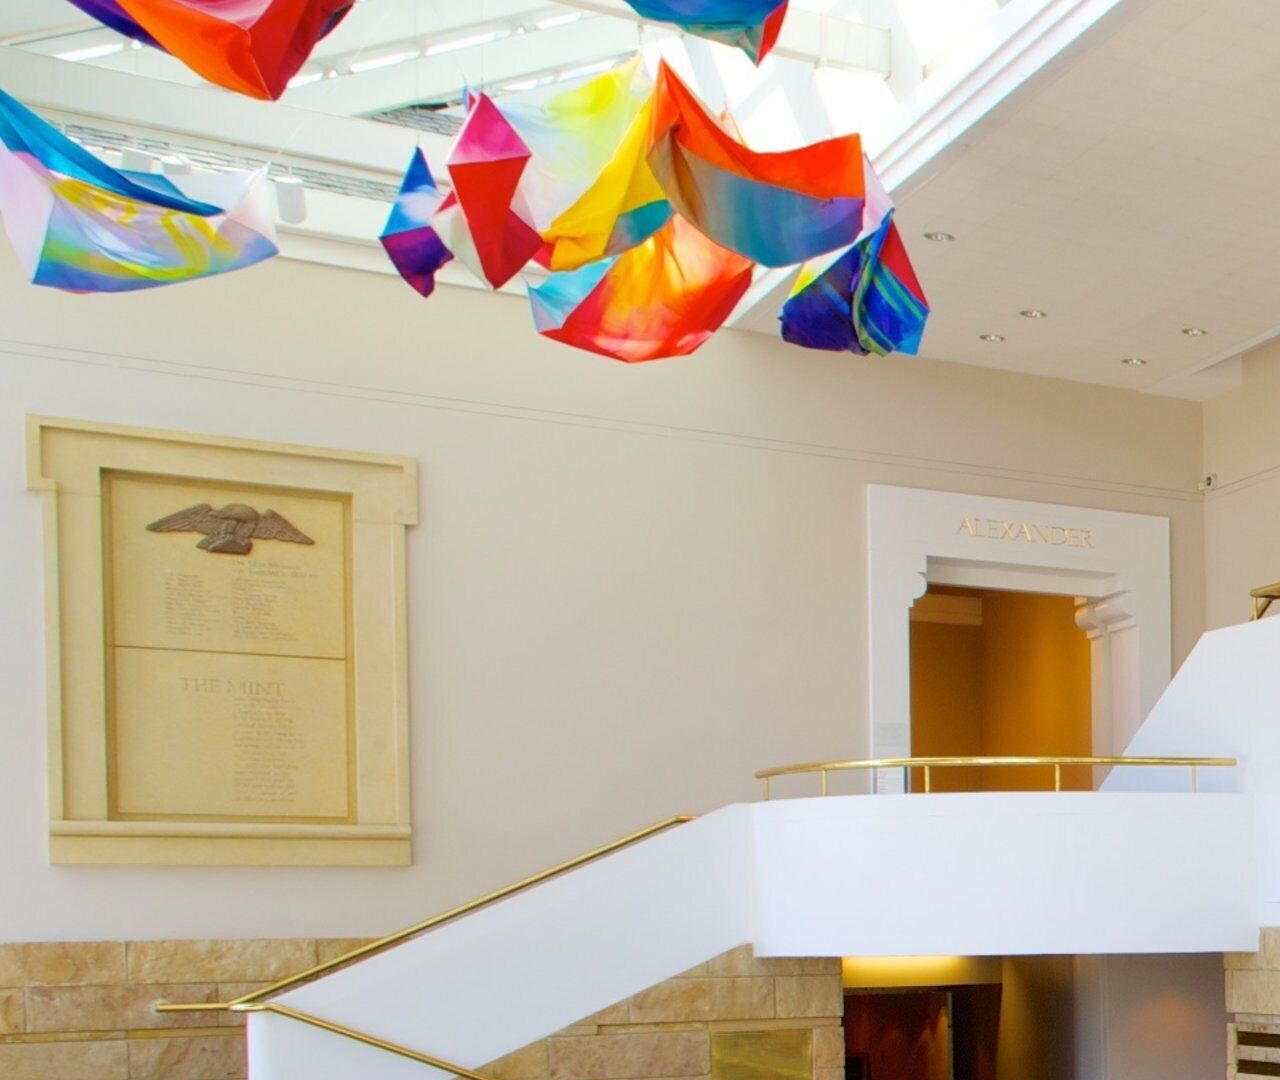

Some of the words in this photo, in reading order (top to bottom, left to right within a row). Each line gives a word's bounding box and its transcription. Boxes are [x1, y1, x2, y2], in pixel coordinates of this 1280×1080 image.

[955, 516, 1095, 549] ALEXANDER
[179, 677, 222, 695] THE
[225, 679, 285, 697] MINT
